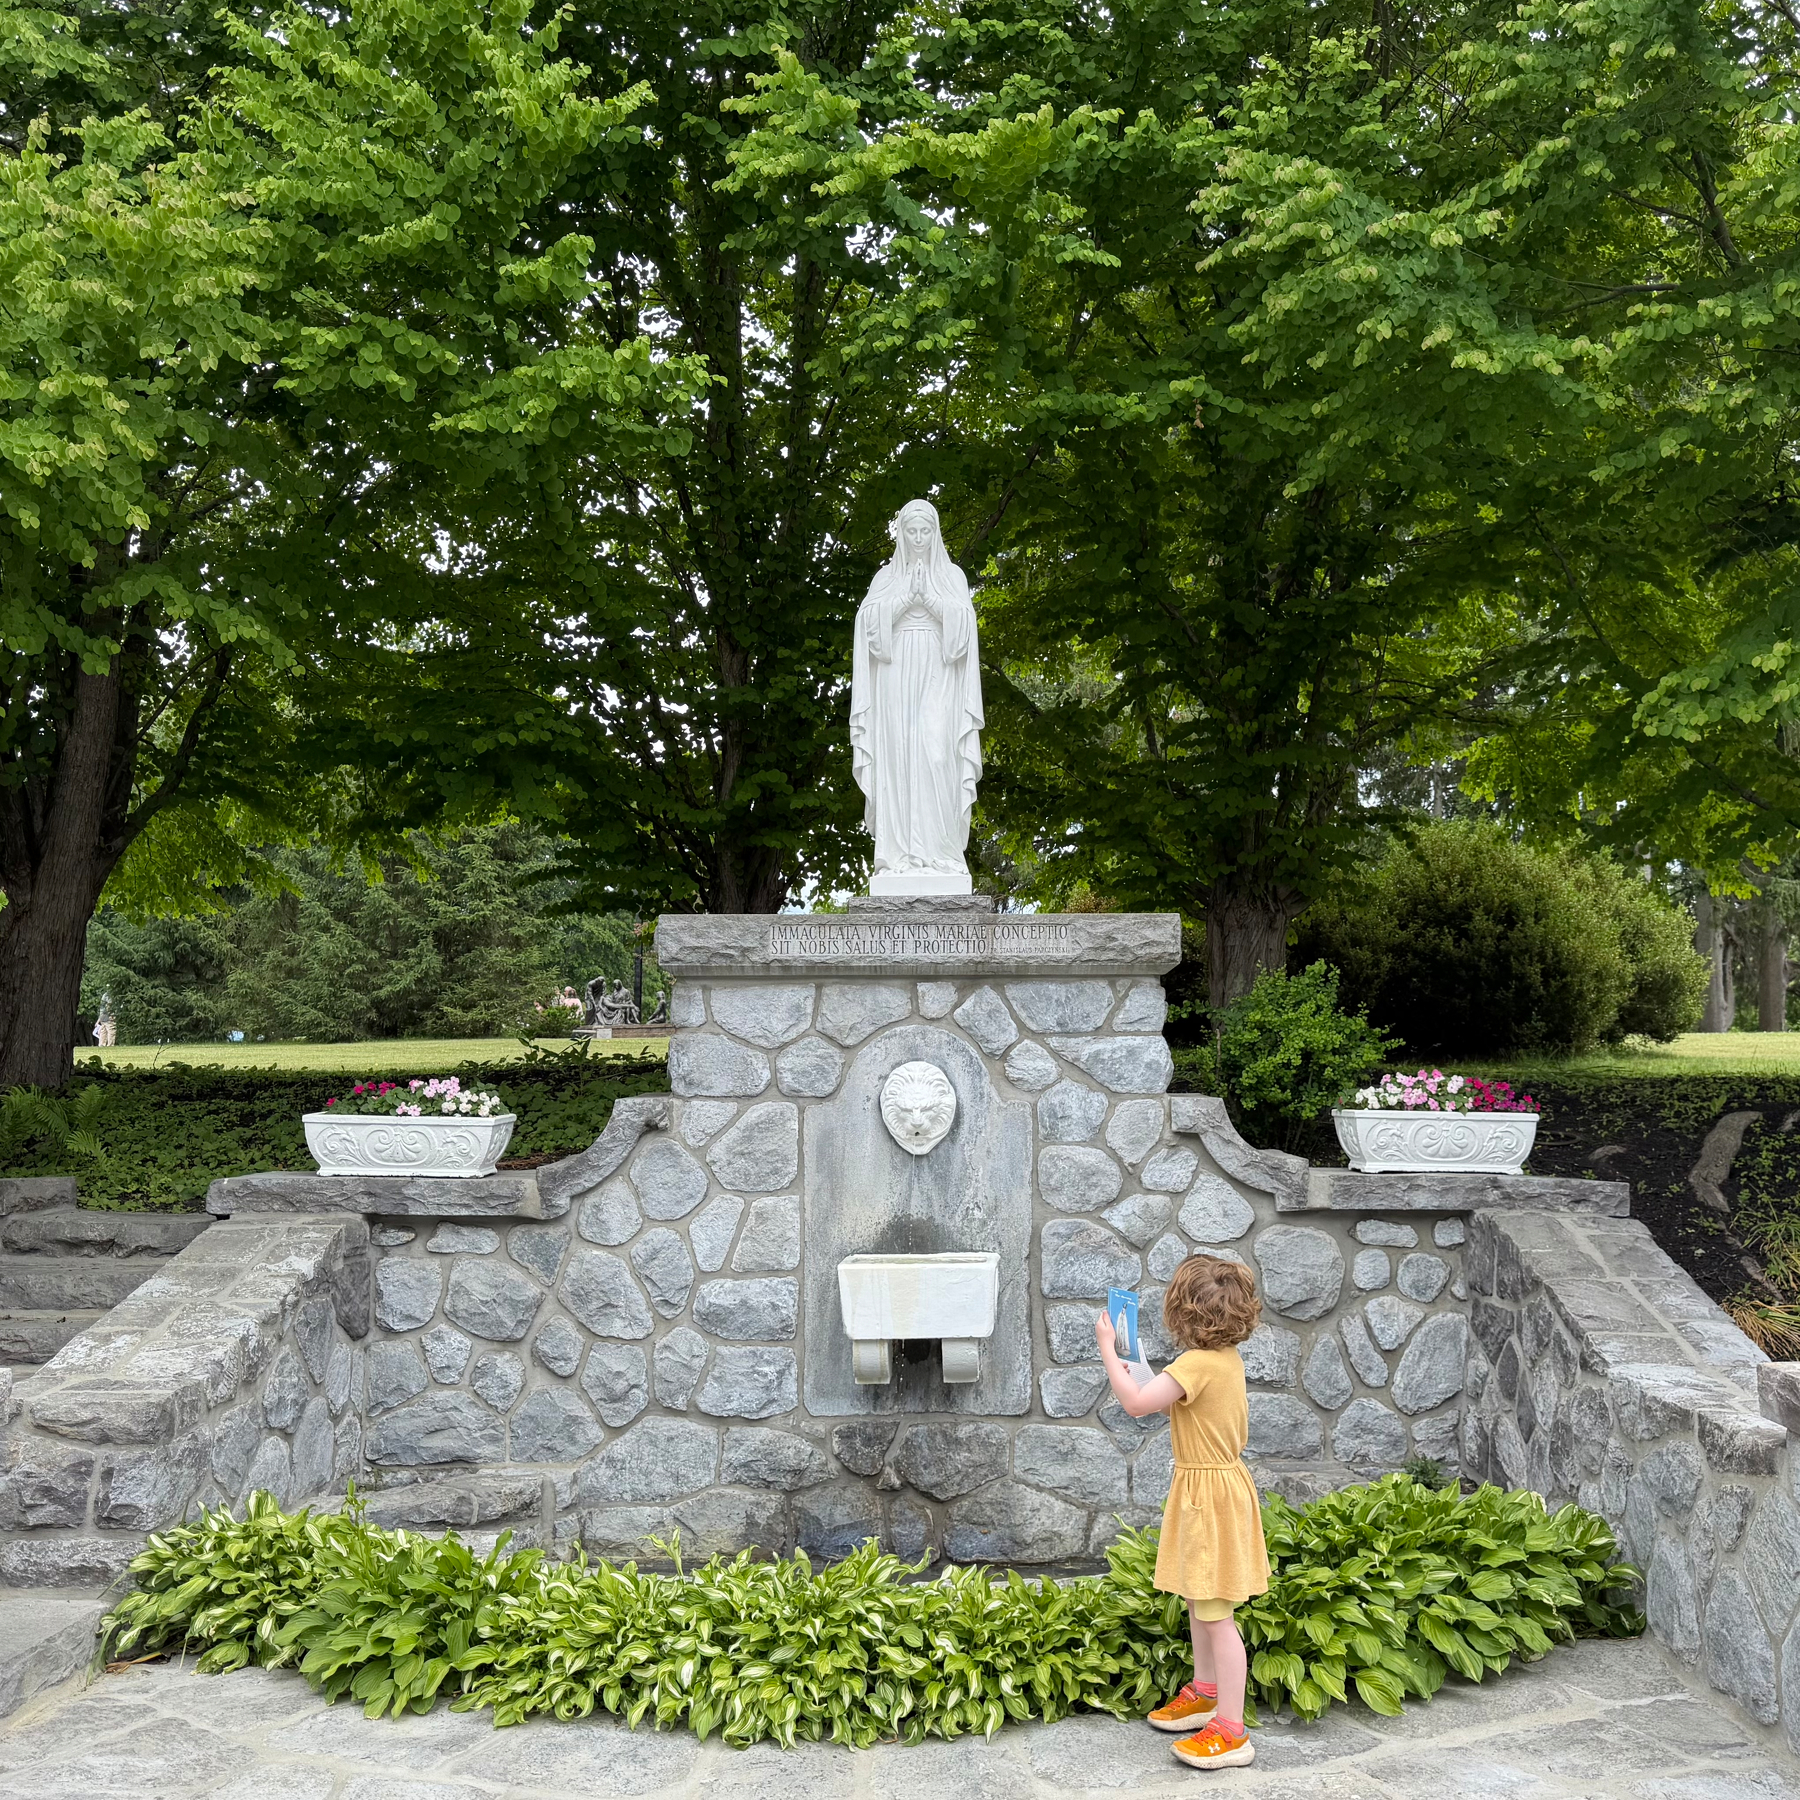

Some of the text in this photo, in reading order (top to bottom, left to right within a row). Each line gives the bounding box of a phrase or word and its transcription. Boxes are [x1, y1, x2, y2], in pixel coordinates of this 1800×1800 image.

[771, 925, 1068, 940] IMMACULATA VIRGINIS MARIAE CONCEPTIO
[771, 940, 986, 955] SIT NOBIS SALUS ET PROTECTIO
